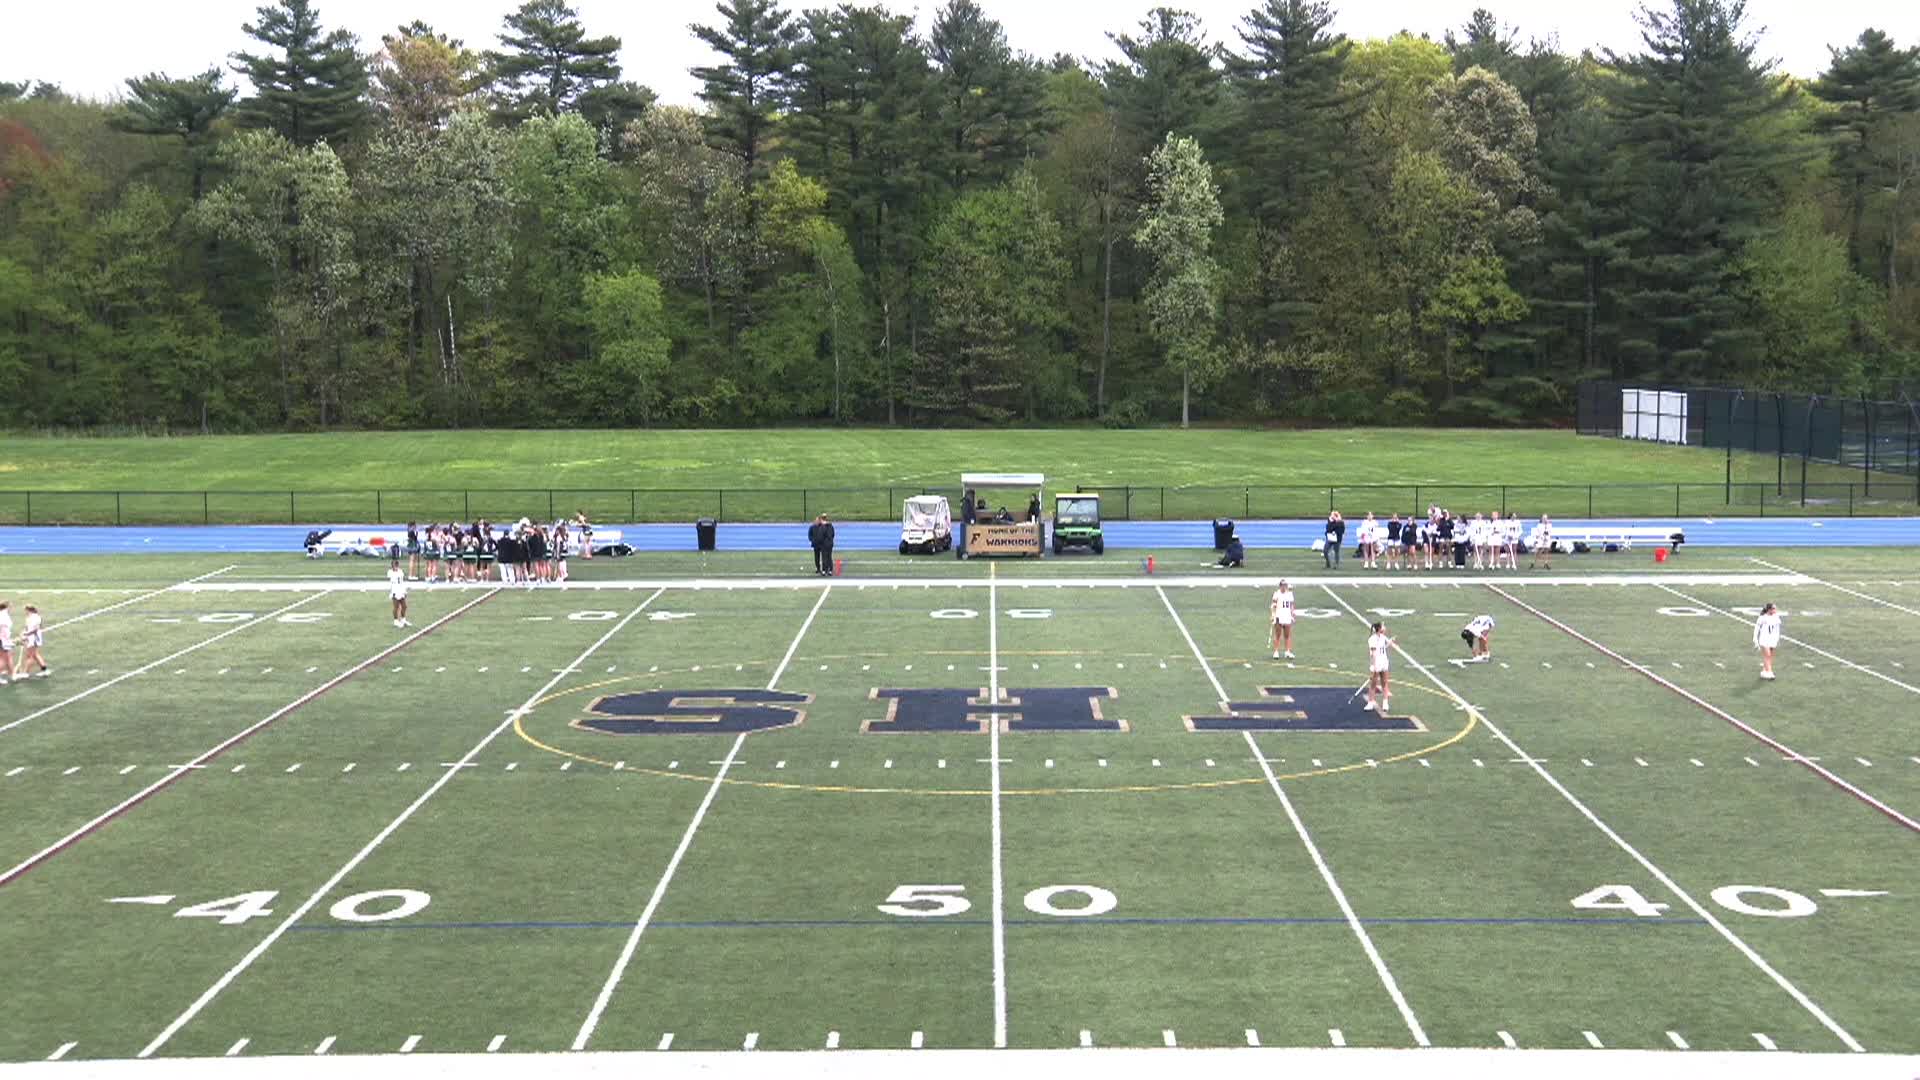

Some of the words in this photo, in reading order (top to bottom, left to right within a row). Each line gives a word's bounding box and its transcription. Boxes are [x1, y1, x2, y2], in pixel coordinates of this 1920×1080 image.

[970, 532, 981, 545] F
[985, 538, 1038, 547] WARRIORS
[172, 889, 432, 924] 40
[876, 884, 1118, 917] 50
[1570, 885, 1819, 918] 40
